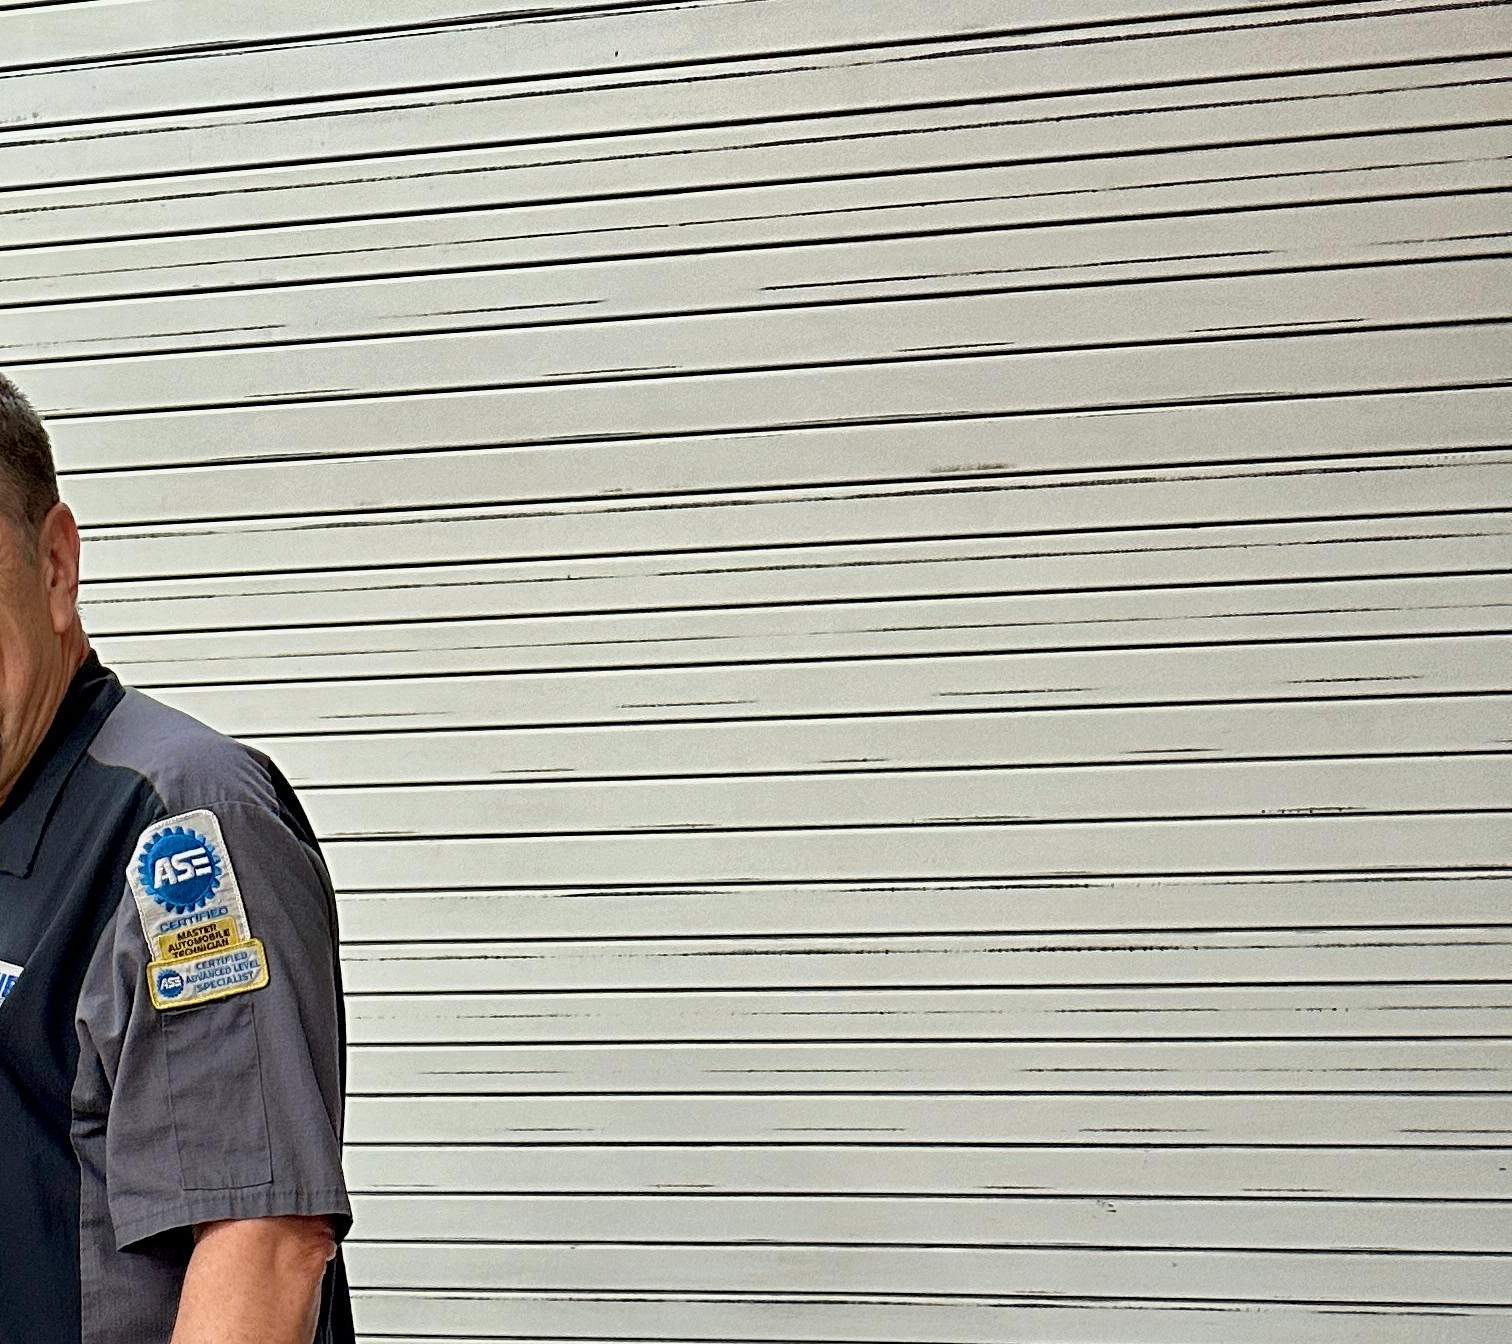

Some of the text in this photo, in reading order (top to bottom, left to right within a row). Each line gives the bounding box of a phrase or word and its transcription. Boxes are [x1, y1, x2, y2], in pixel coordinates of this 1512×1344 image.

[154, 847, 212, 890] ASE
[160, 906, 228, 932] CERTIFIED
[168, 928, 230, 953] AUTOMOBILE
[177, 923, 217, 941] MASTER
[186, 960, 261, 985] ADVANCED LEVEL
[196, 951, 248, 971] CERTIFIED
[160, 976, 182, 991] ASE
[196, 971, 254, 993] SPECIALIST
